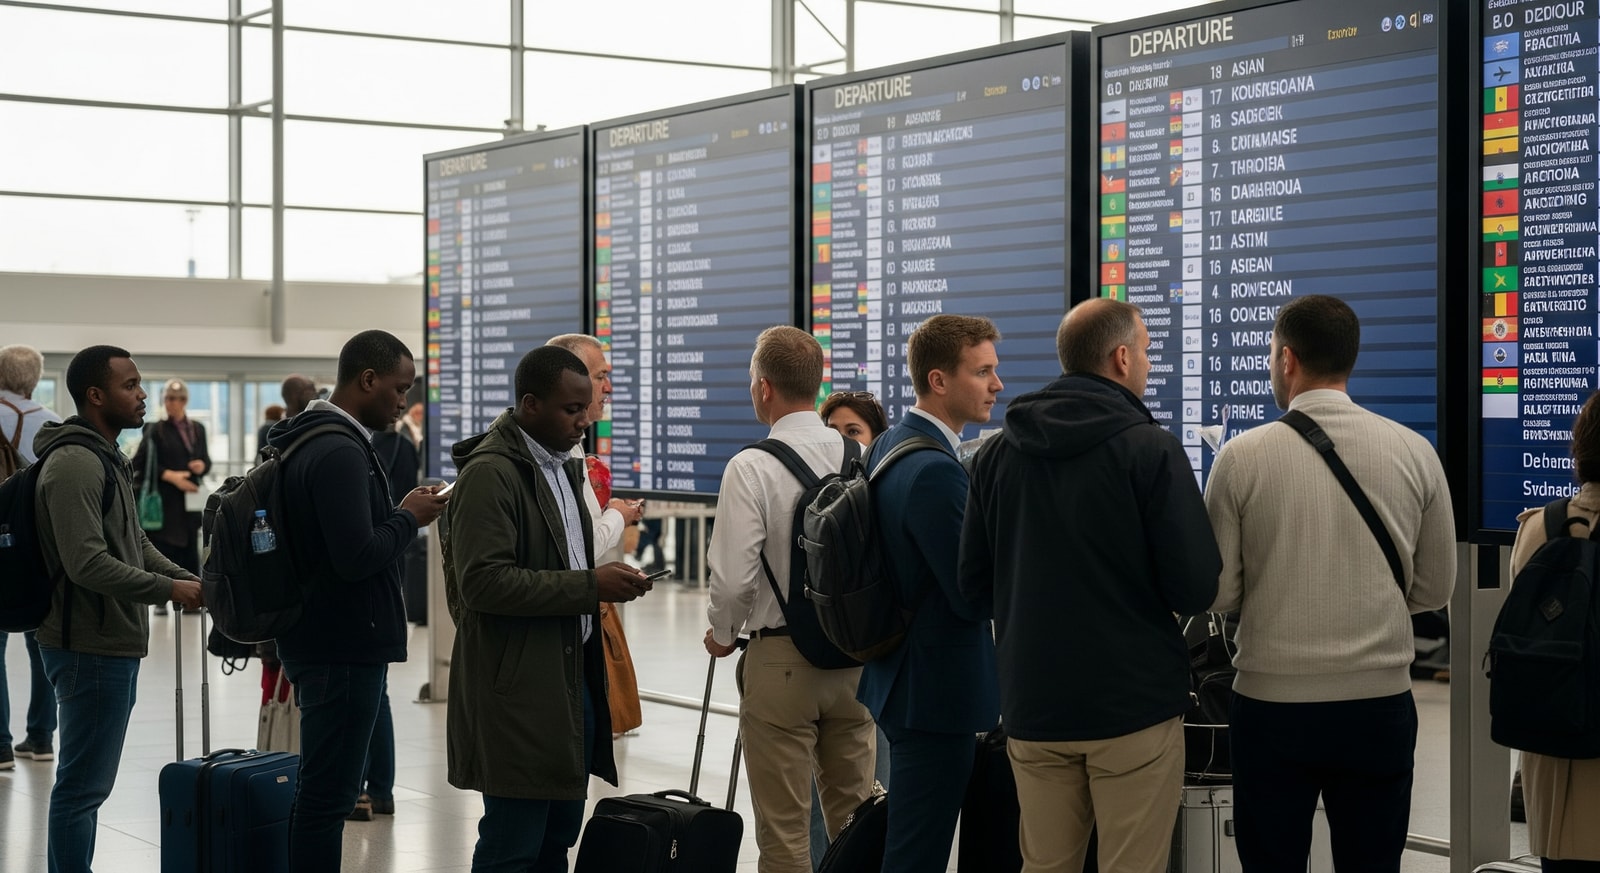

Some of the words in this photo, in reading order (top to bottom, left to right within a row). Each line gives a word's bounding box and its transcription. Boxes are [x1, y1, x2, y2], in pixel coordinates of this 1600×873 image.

[1130, 16, 1233, 57] DEPARTURE
[1231, 57, 1265, 78] ASIAN
[835, 75, 912, 109] DEPARTURE
[1210, 88, 1223, 105] 17
[609, 119, 669, 148] DEPARTURE
[1209, 259, 1222, 275] 16
[1208, 308, 1222, 324] 16
[1211, 332, 1219, 348] 9
[1208, 356, 1222, 372] 16
[1211, 404, 1219, 420] 5
